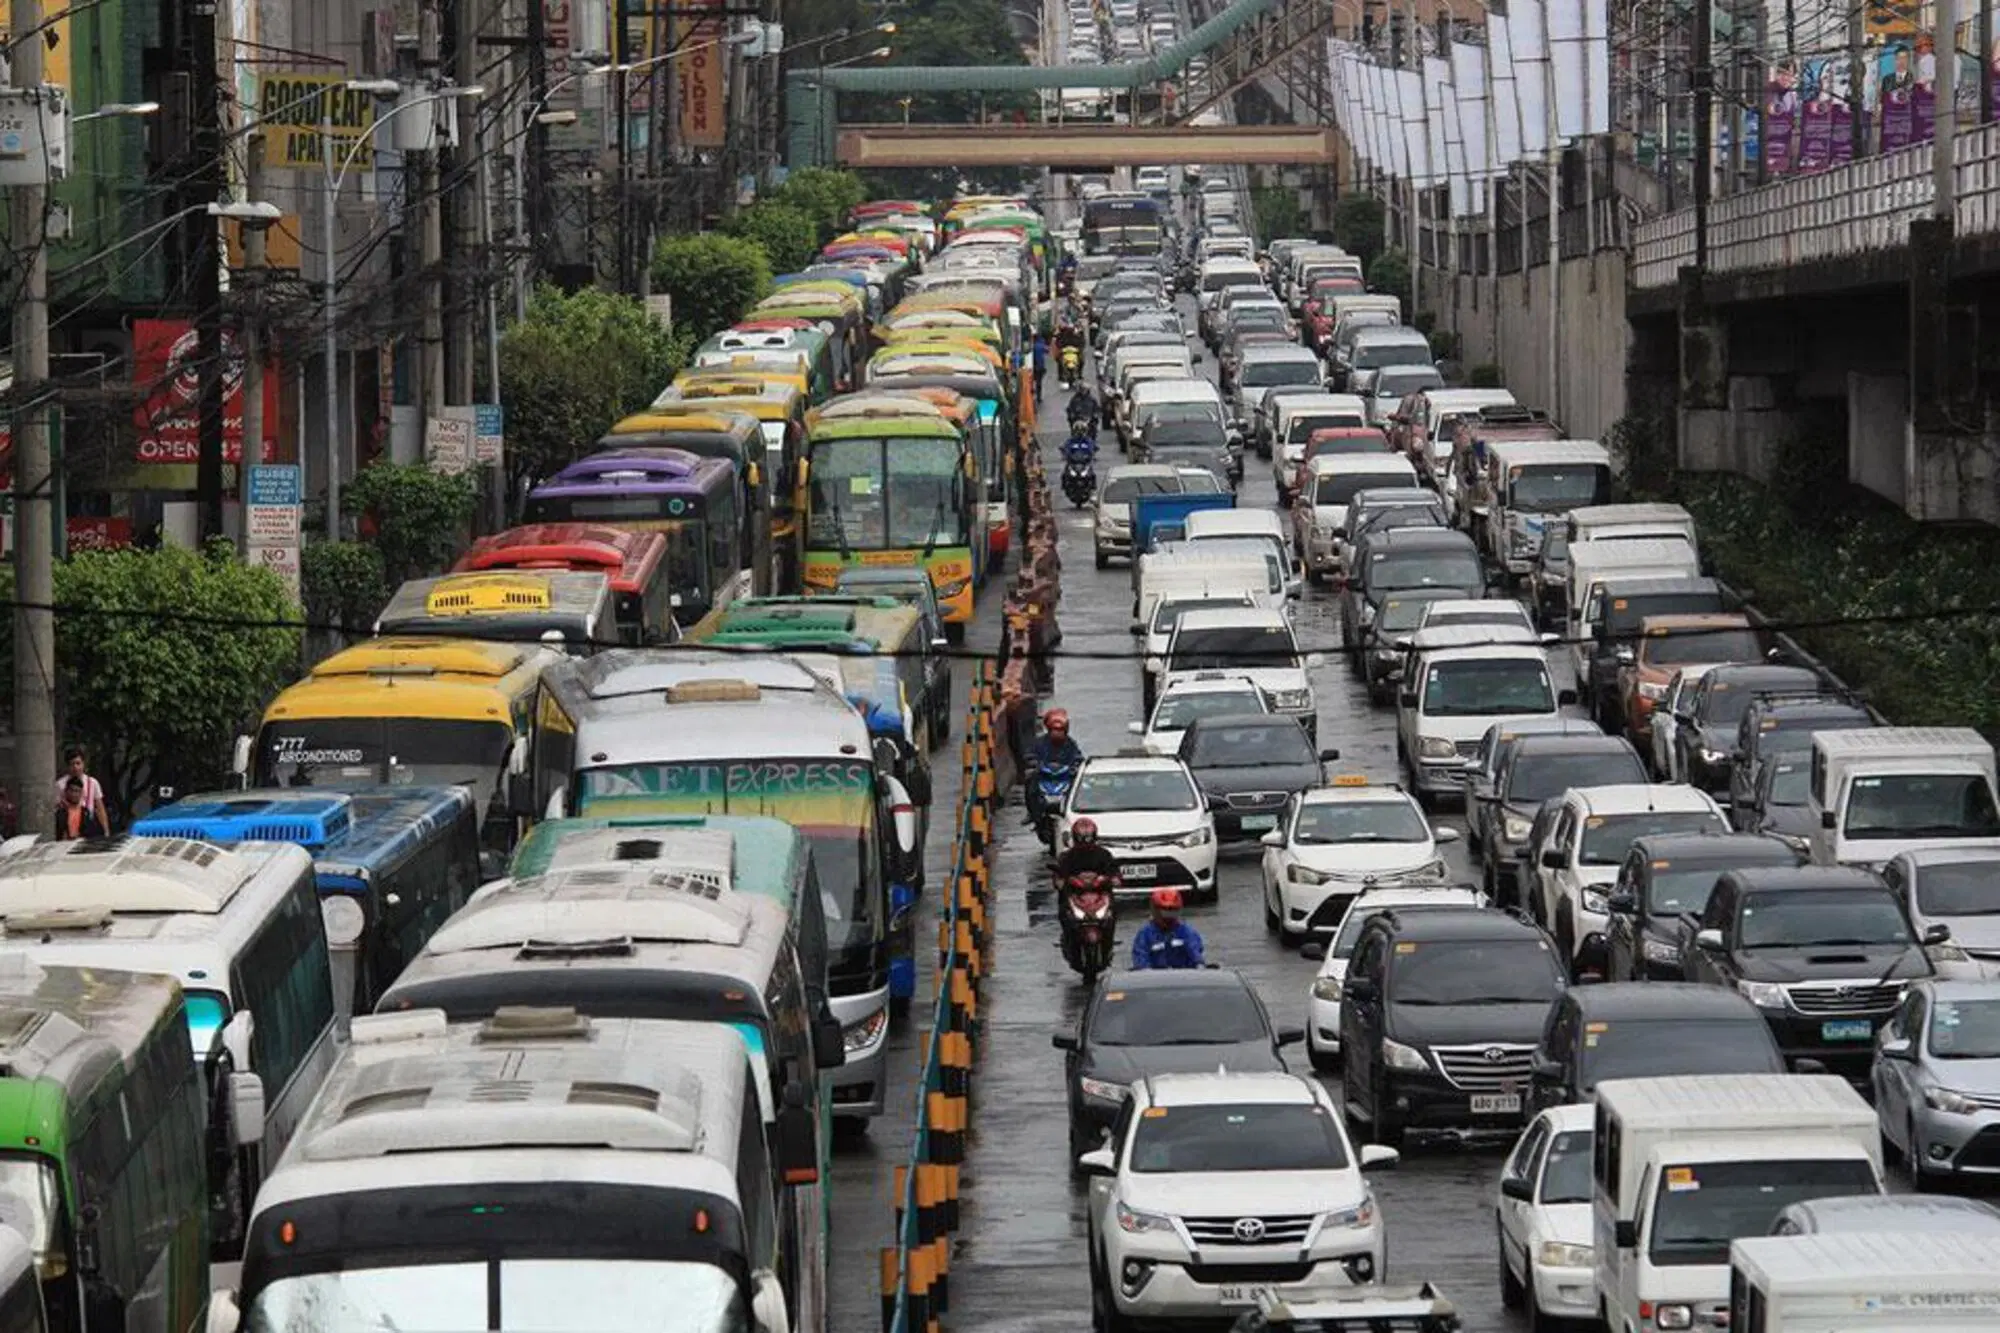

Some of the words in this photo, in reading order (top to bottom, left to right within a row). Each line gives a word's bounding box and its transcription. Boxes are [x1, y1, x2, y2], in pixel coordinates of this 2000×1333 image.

[140, 440, 200, 457] OPEN
[261, 548, 286, 562] NO
[726, 763, 865, 793] EXPRESS
